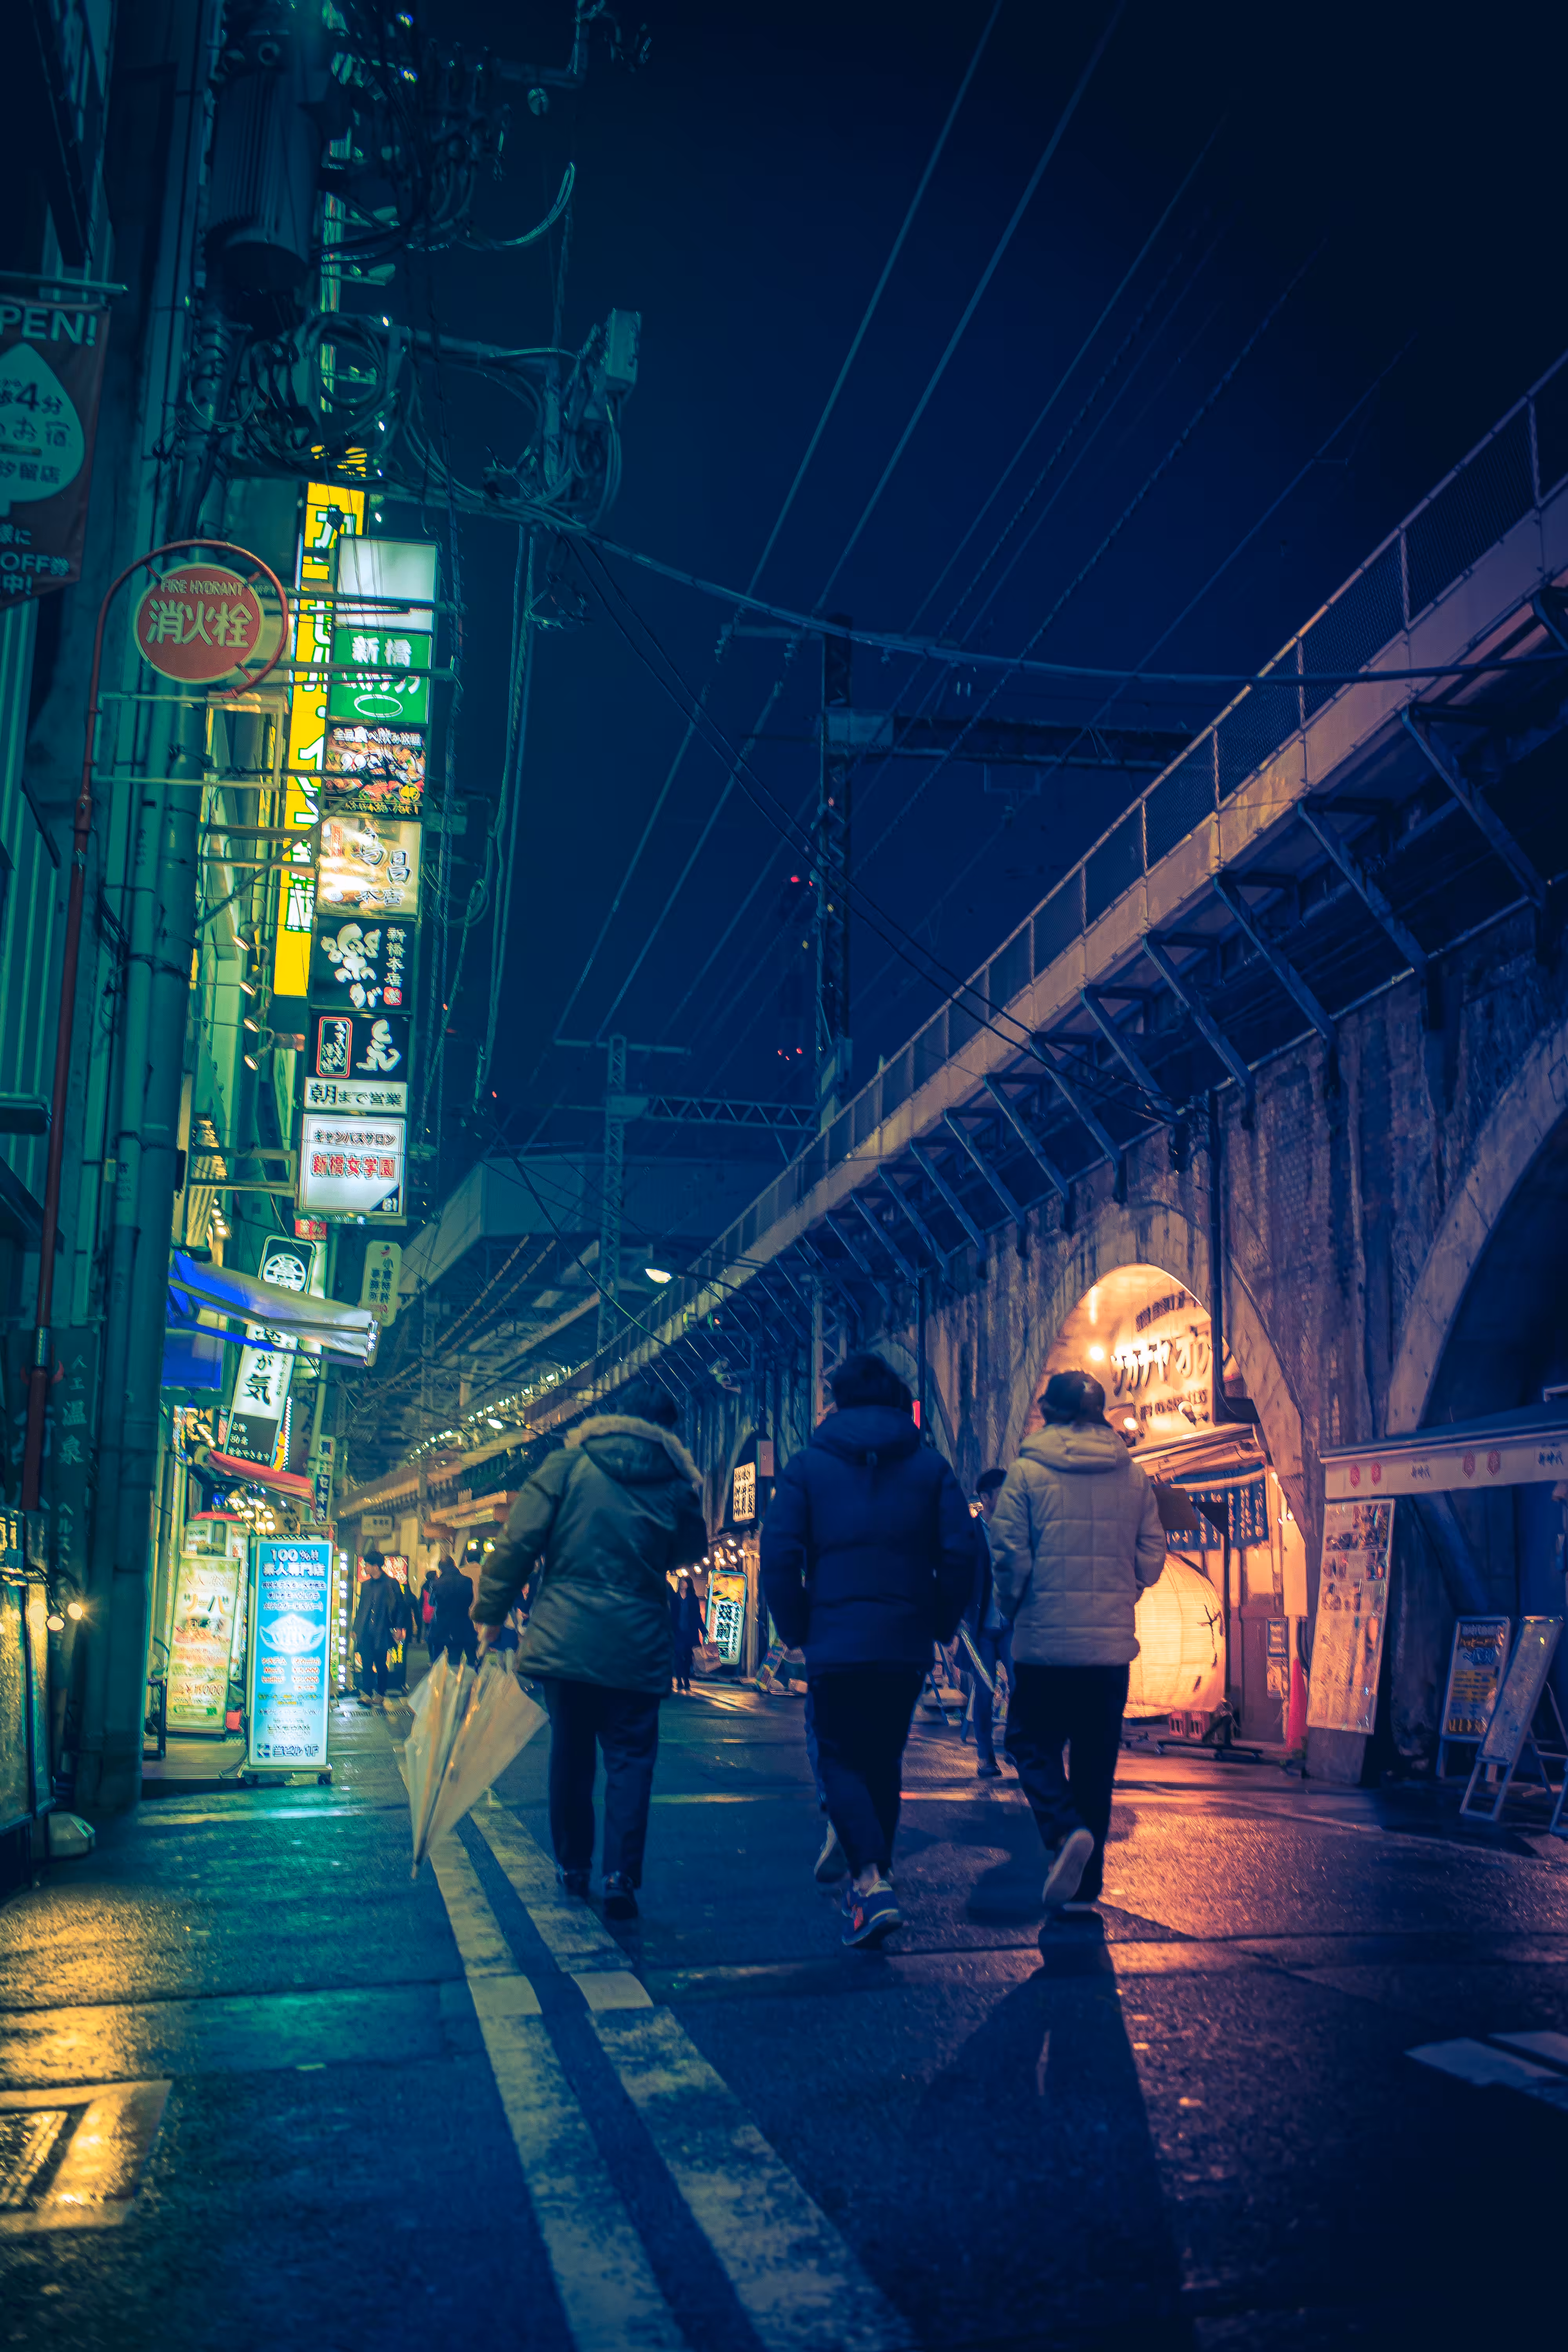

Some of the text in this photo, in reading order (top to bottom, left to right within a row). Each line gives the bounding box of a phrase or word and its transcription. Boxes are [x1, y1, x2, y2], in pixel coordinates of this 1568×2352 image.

[0, 416, 71, 447] お宿
[160, 579, 244, 596] FIRE HYDRANT
[146, 599, 254, 648] 消火栓
[352, 635, 412, 668] 新橋
[309, 1082, 403, 1107] 朝まで営業
[312, 1152, 395, 1178] 新橋女学園
